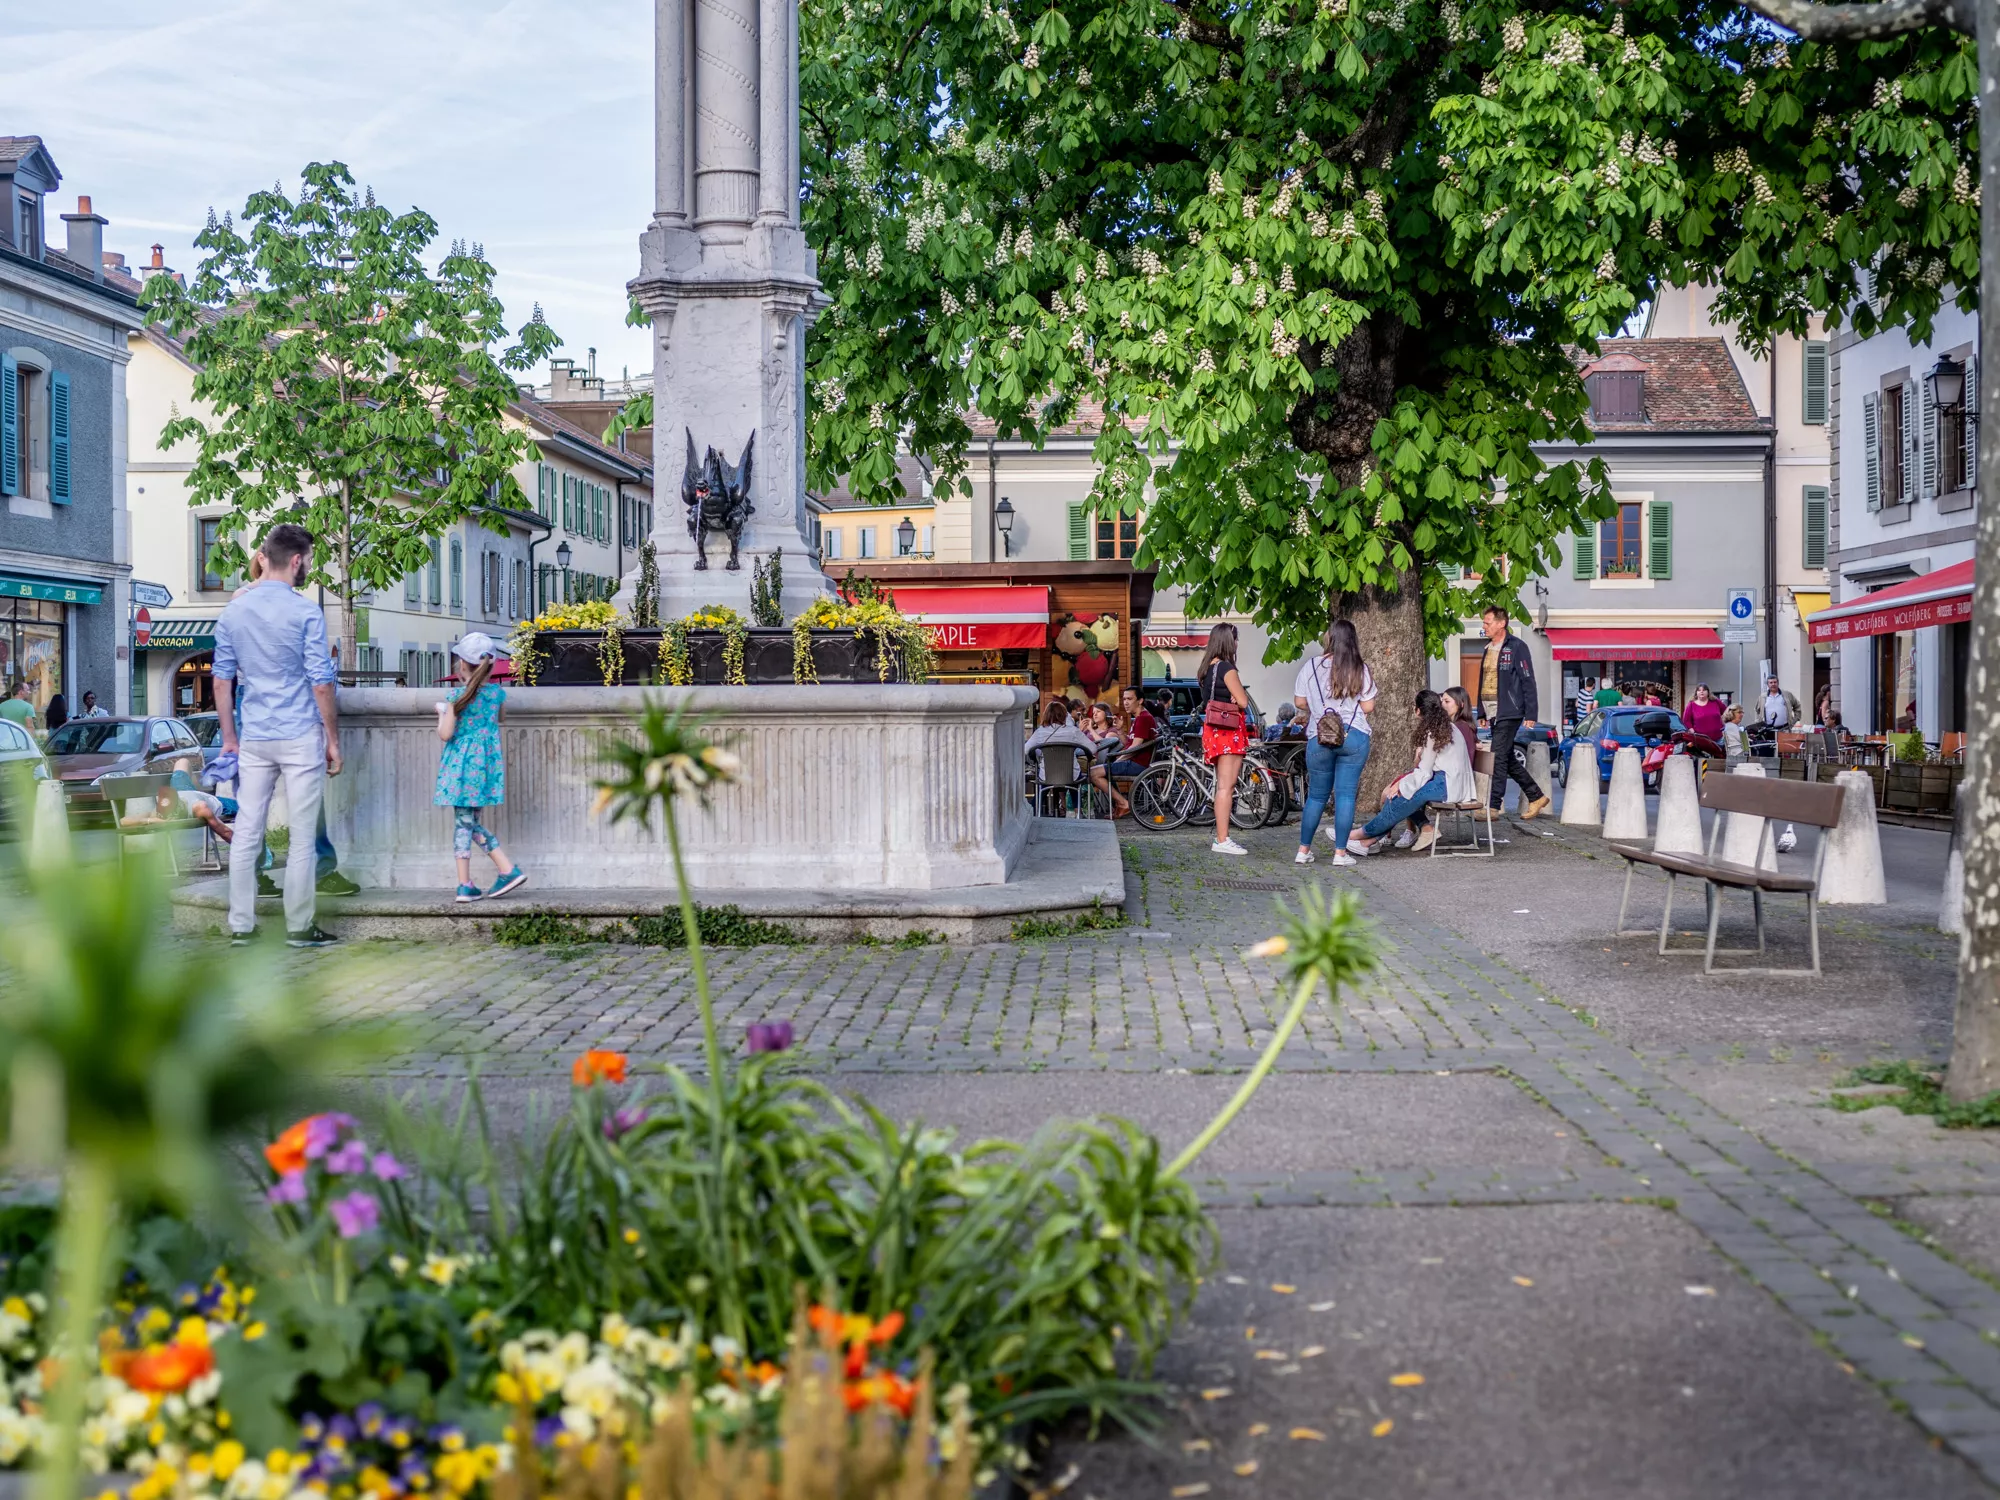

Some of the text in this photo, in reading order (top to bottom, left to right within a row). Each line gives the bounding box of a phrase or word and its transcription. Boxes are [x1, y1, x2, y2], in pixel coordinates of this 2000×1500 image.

[924, 625, 977, 645] MPLE
[147, 637, 194, 647] CUCCAGNA
[1147, 636, 1178, 646] VINS
